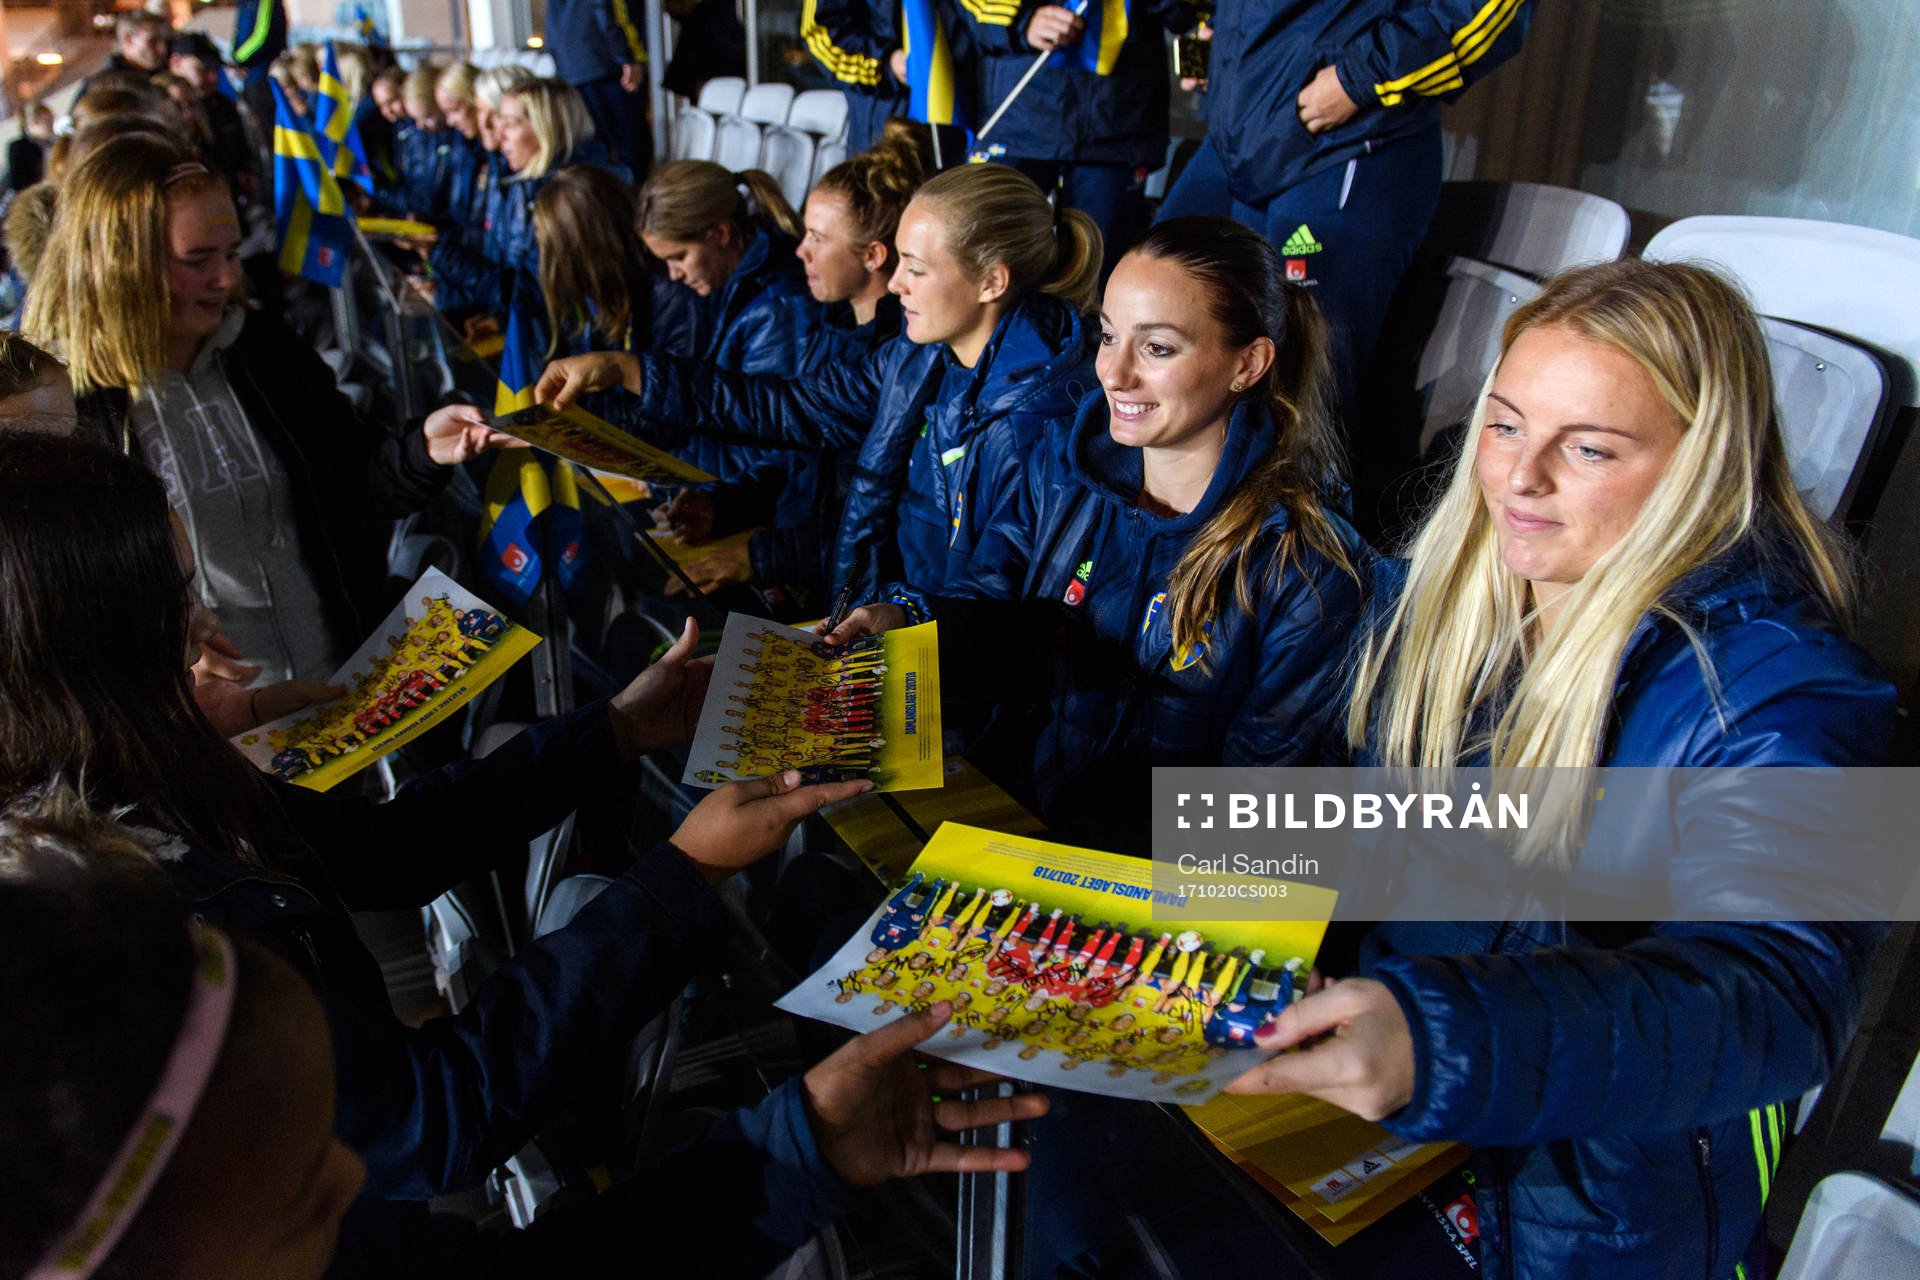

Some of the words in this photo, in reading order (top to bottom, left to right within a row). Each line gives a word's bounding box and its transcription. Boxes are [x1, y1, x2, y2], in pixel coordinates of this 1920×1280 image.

[1282, 242, 1323, 256] adidas
[1033, 865, 1080, 887] 2017/18
[1081, 872, 1188, 907] DAMLANDSLAGET
[1454, 1242, 1478, 1270] SPEL
